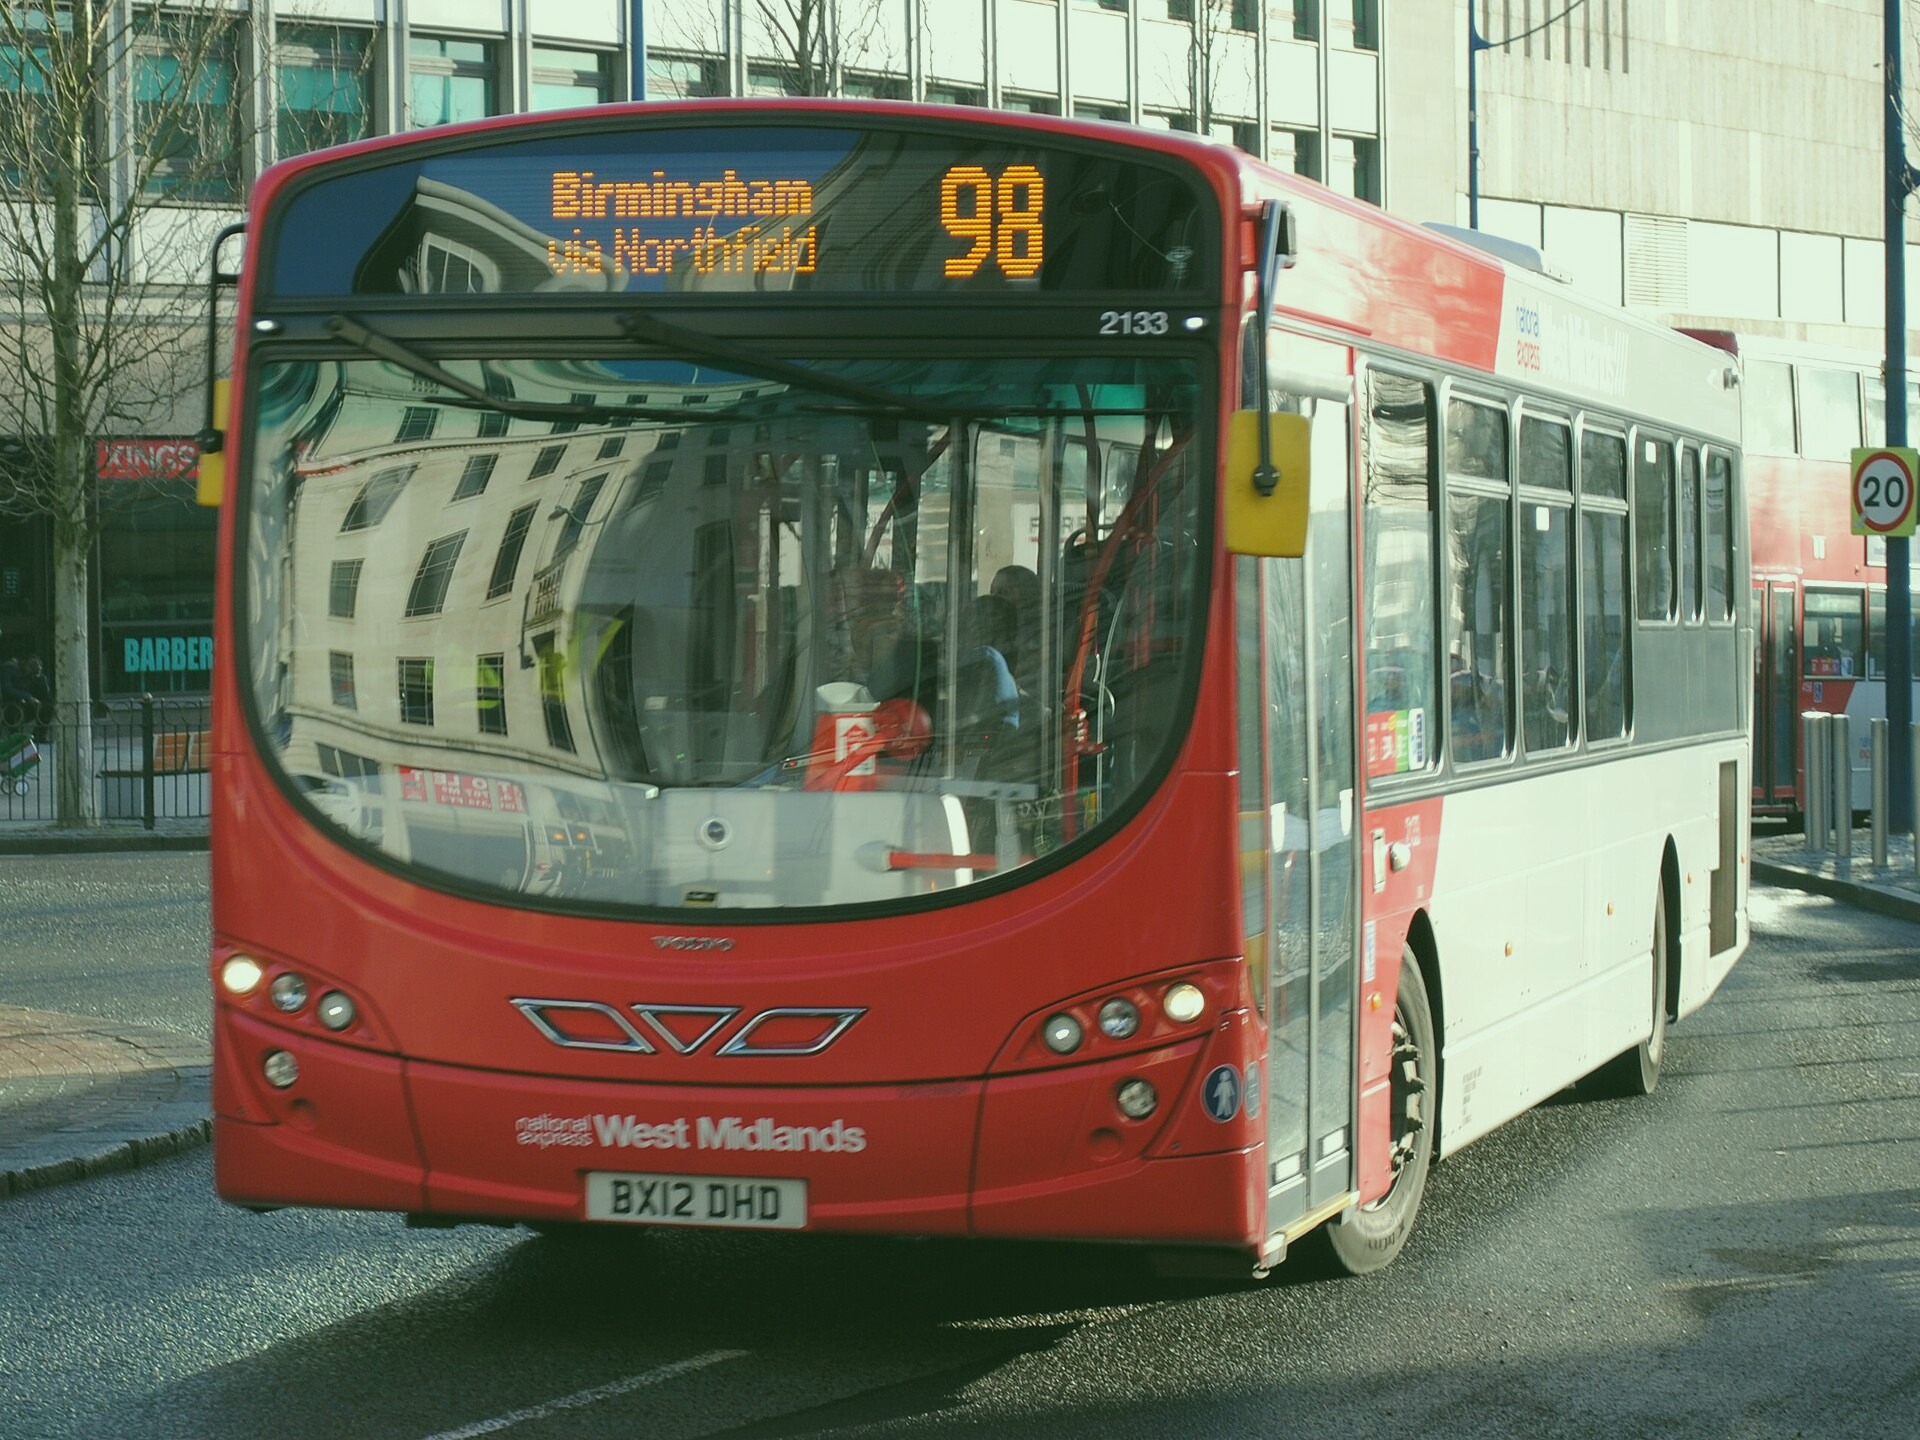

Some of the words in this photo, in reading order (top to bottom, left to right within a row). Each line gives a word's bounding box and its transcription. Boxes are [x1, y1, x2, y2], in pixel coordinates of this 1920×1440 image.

[552, 170, 812, 218] Birmingham
[941, 165, 1044, 277] 98
[548, 228, 602, 275] via
[614, 226, 817, 274] Northfield
[1099, 310, 1169, 335] 2133
[1863, 475, 1904, 508] 20
[514, 1113, 592, 1132] national
[516, 1130, 594, 1150] express
[593, 1114, 691, 1150] West
[696, 1115, 867, 1153] Midlands
[611, 1178, 696, 1217] BX12
[706, 1182, 781, 1221] DHD
